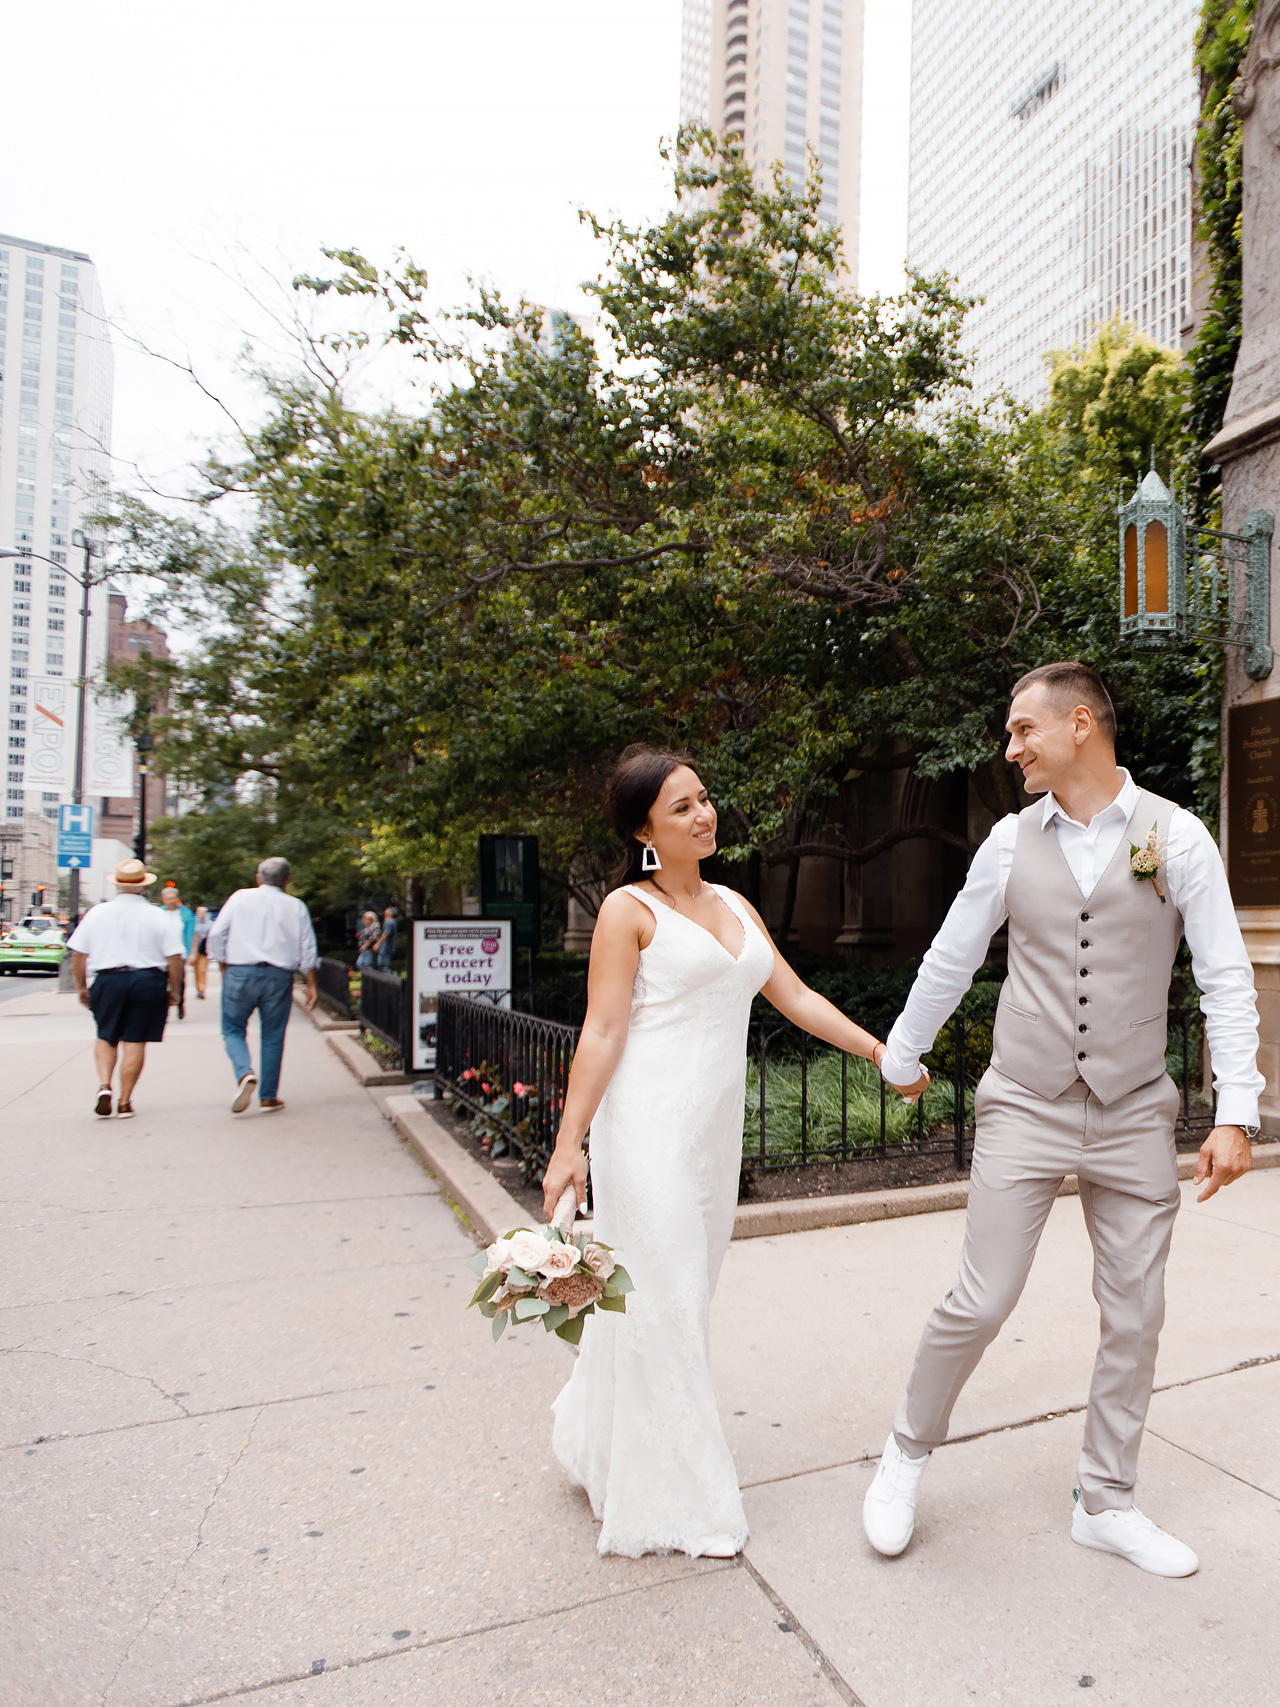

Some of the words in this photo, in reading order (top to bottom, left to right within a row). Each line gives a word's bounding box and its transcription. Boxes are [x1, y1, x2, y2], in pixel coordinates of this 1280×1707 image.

[31, 681, 65, 774] EXPO
[1251, 724, 1272, 736] Fourth
[1250, 748, 1272, 760] Church
[62, 806, 89, 832] H
[439, 943, 475, 956] Free
[428, 956, 494, 969] Concert
[445, 970, 492, 987] today
